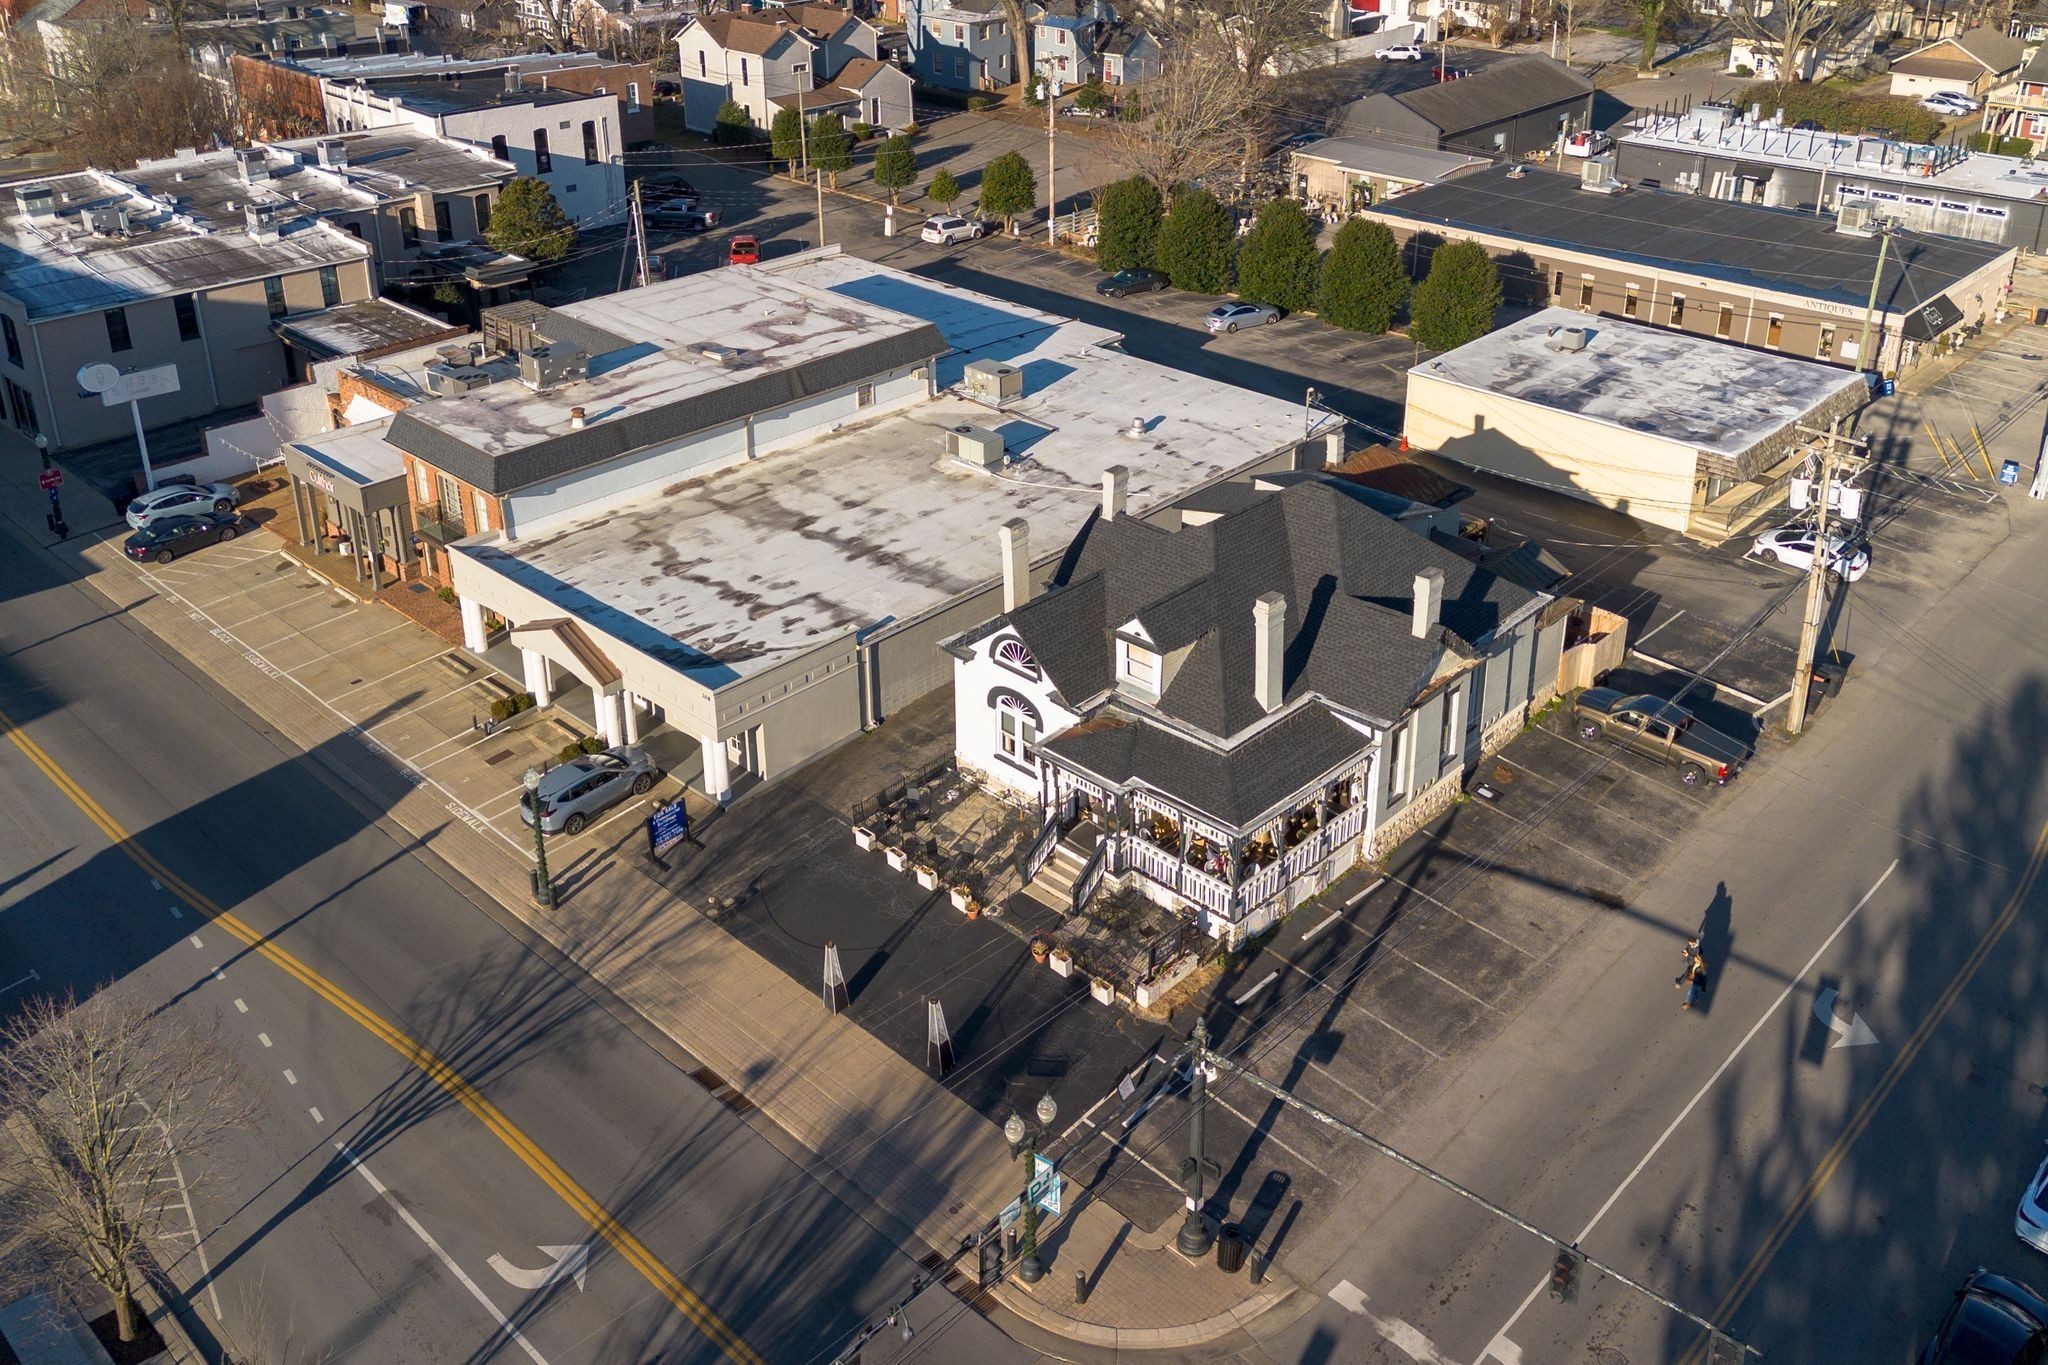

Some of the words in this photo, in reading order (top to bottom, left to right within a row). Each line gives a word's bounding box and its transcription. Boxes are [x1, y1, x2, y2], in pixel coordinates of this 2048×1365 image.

[1804, 300, 1853, 316] ANTIQUES
[244, 653, 279, 679] SIDEWALK
[400, 768, 429, 790] BLOCK
[444, 802, 488, 833] SIDEWALK
[1031, 1181, 1041, 1203] P
